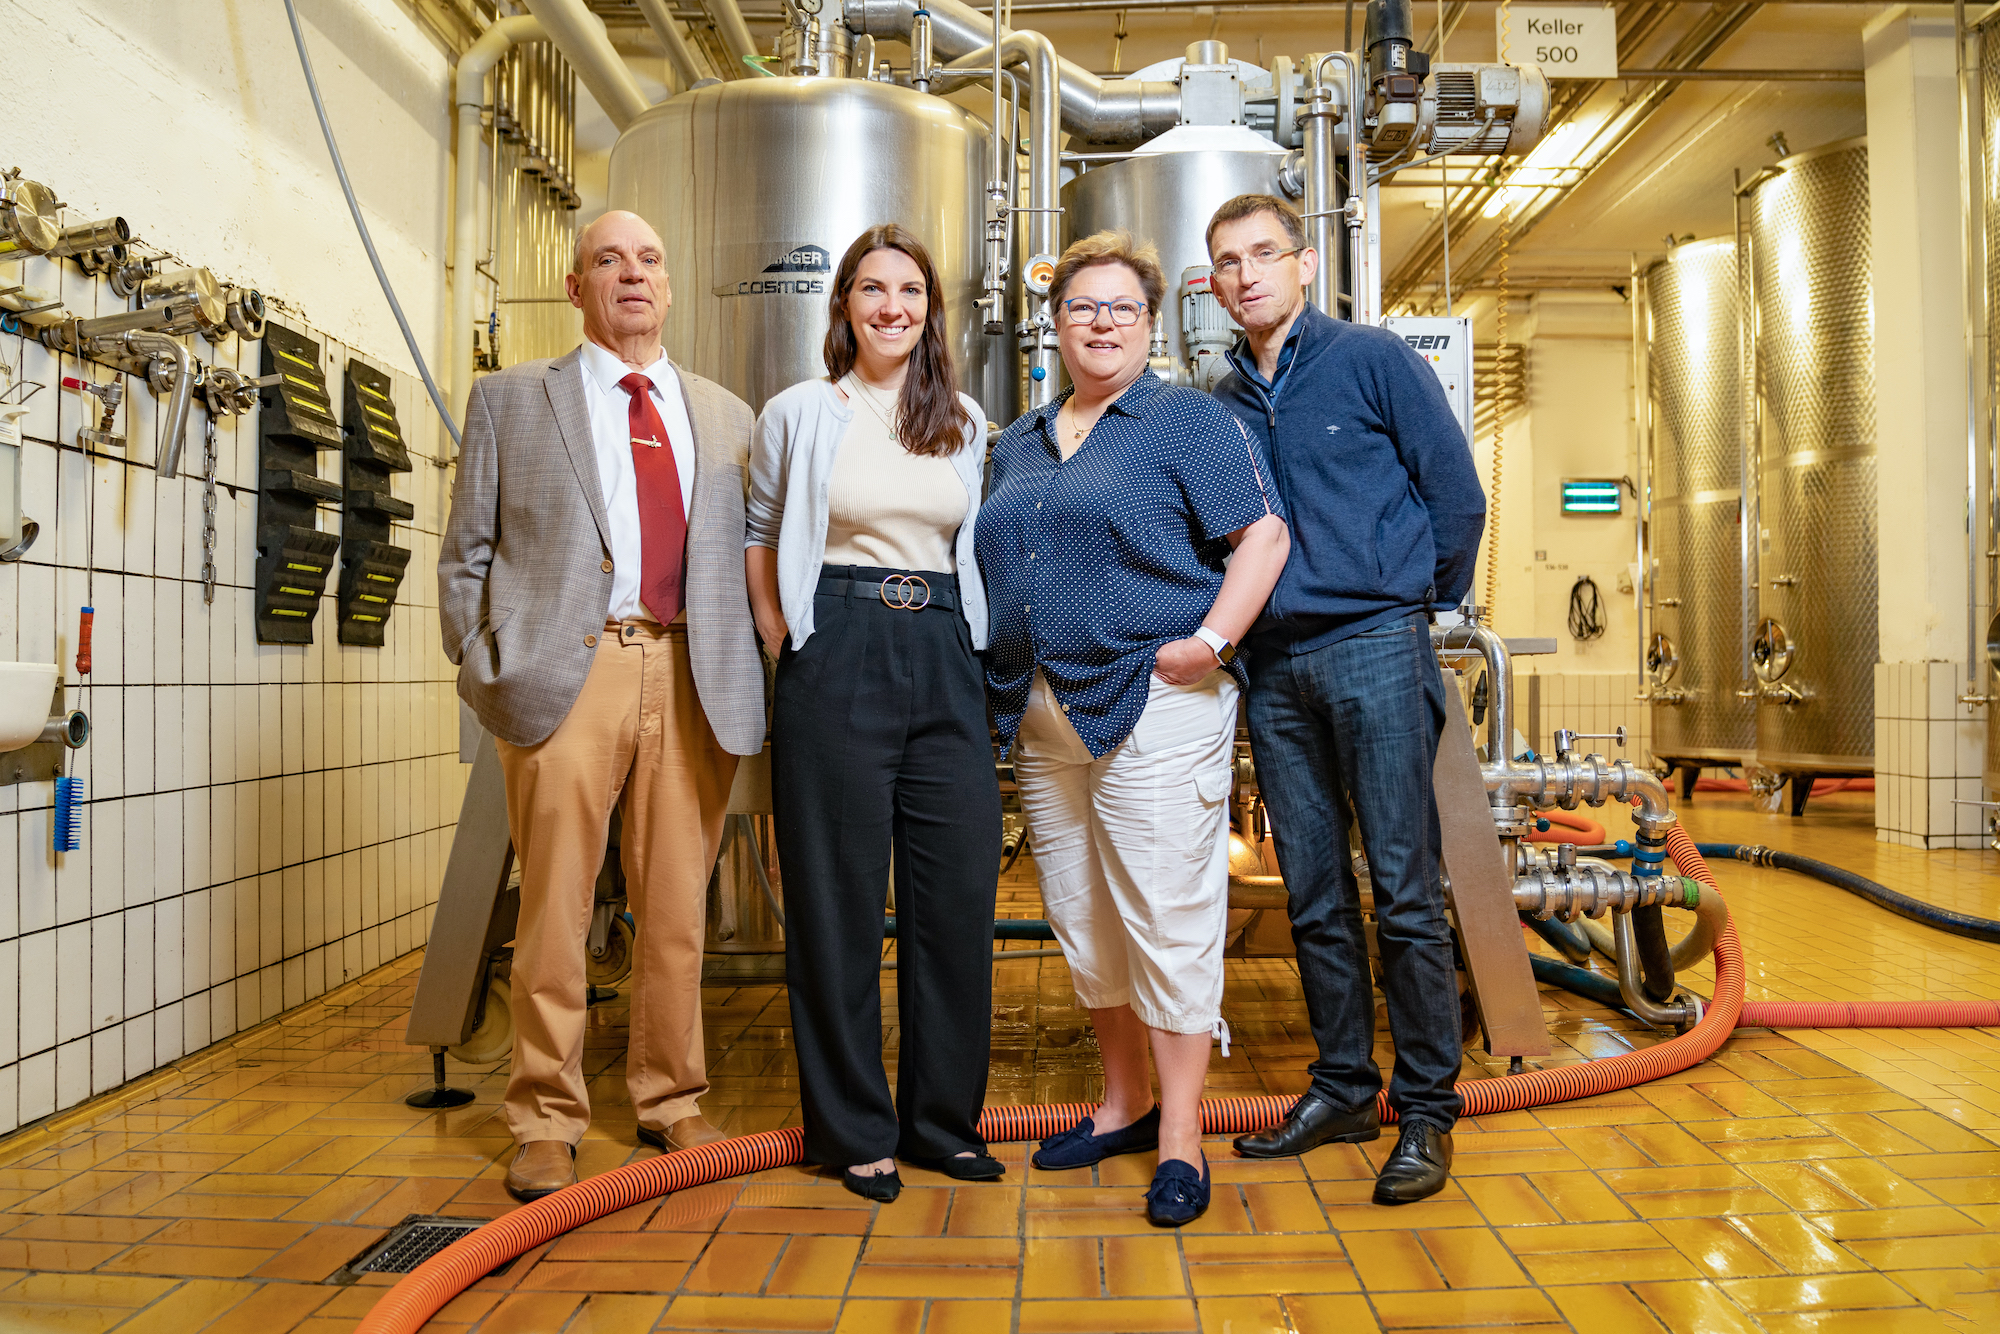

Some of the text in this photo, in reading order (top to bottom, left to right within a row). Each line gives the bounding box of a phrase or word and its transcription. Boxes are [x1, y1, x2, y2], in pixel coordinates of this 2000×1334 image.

[1528, 18, 1584, 35] Keller
[1536, 46, 1578, 63] 500
[738, 280, 824, 294] COSMOS
